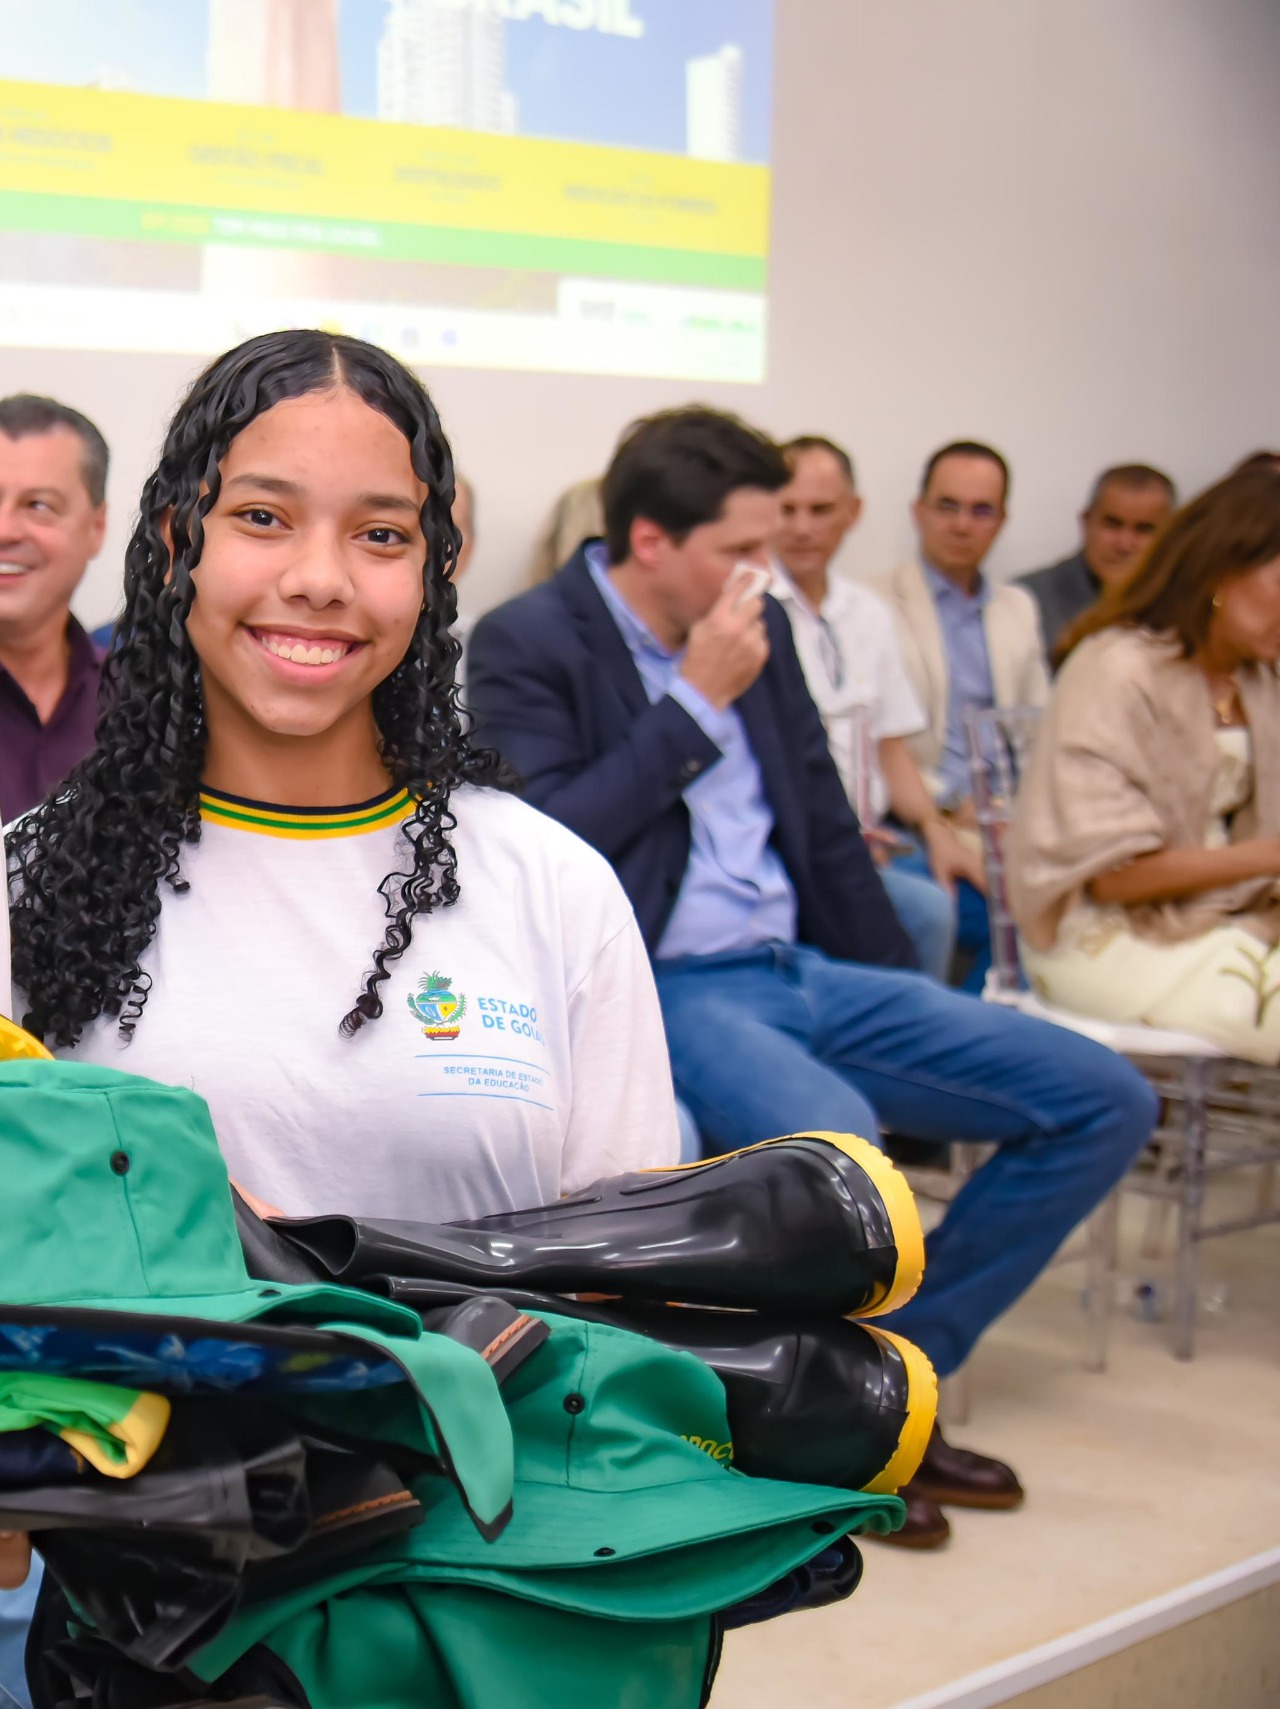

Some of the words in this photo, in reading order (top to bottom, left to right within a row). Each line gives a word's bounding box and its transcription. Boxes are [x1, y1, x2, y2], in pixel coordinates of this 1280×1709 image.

[477, 997, 537, 1023] ESTADO
[482, 1014, 506, 1031] DE
[443, 1066, 504, 1077] SECRETARIA
[505, 1070, 516, 1079] DE
[468, 1077, 481, 1086] DA
[484, 1078, 530, 1092] EDUCAÇÃO
